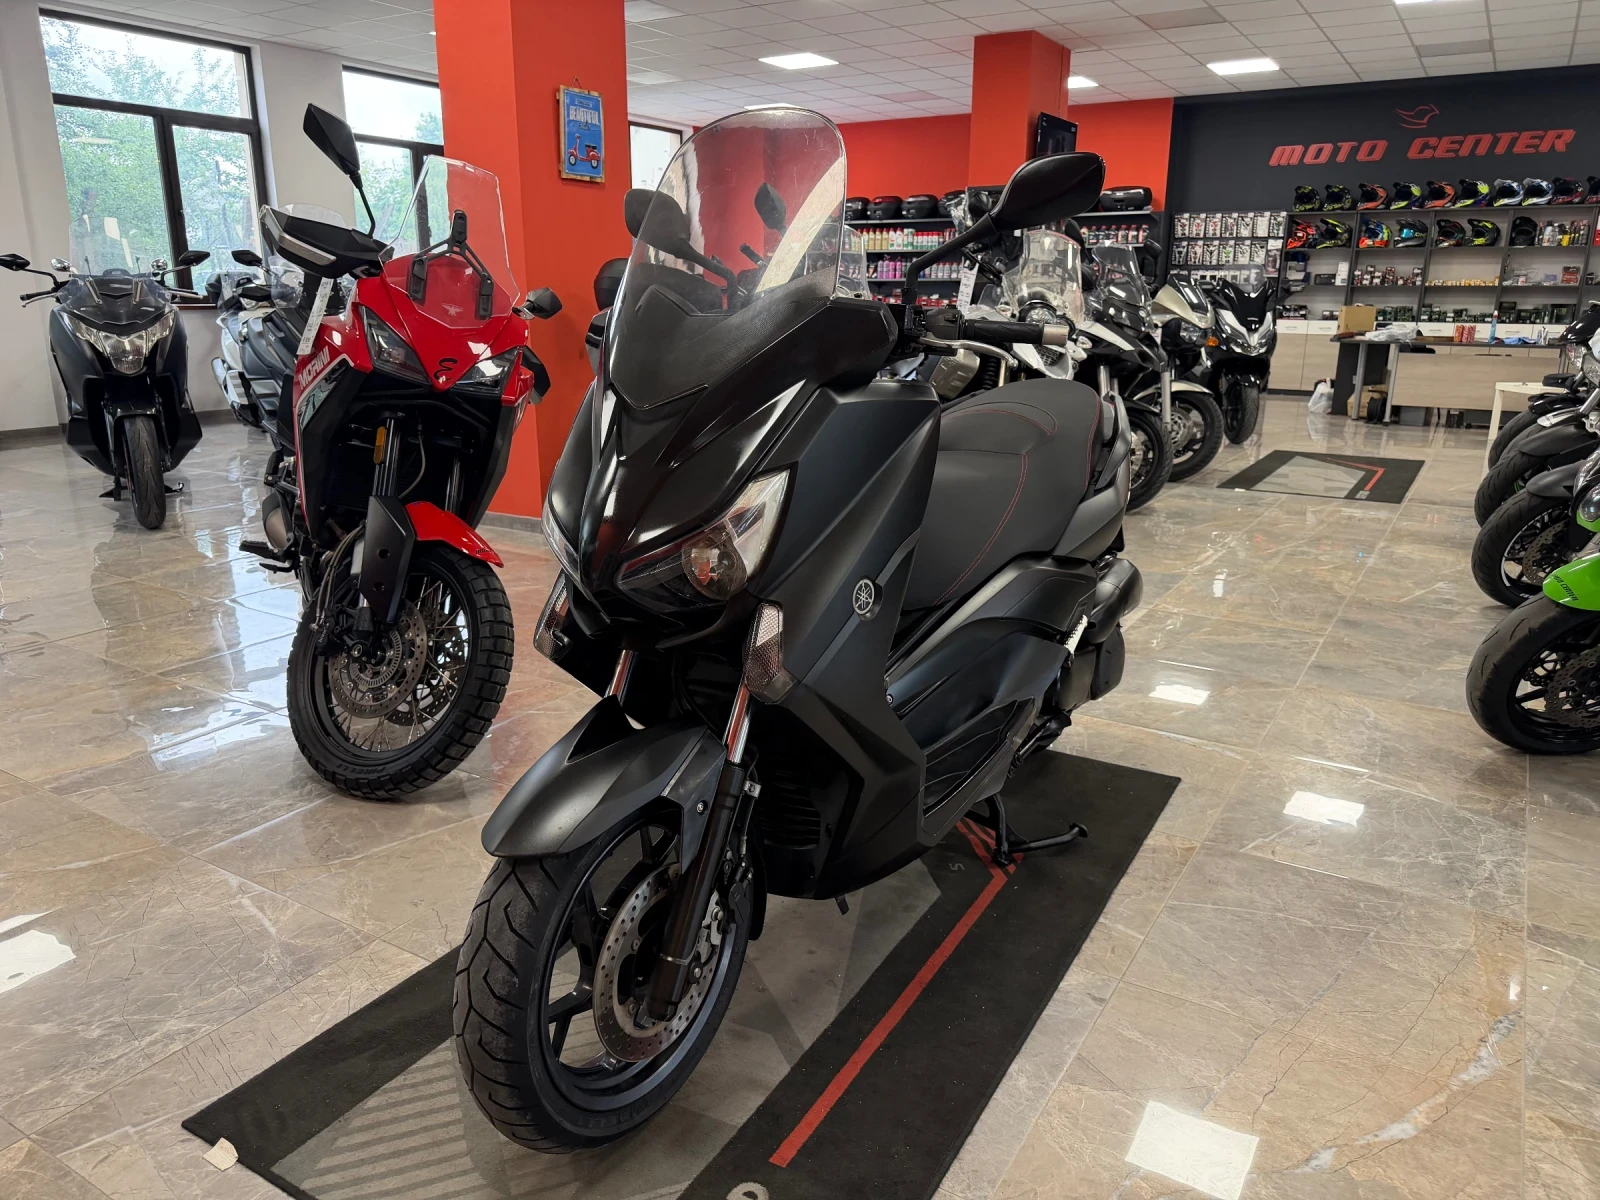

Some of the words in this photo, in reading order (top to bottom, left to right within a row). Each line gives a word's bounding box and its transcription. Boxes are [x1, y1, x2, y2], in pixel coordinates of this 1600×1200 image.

[569, 105, 600, 126] BEAUTIFUL
[1269, 140, 1388, 166] MOTO
[1406, 129, 1576, 159] CENTER
[298, 345, 331, 390] MORINI
[336, 763, 386, 775] PIRELLI
